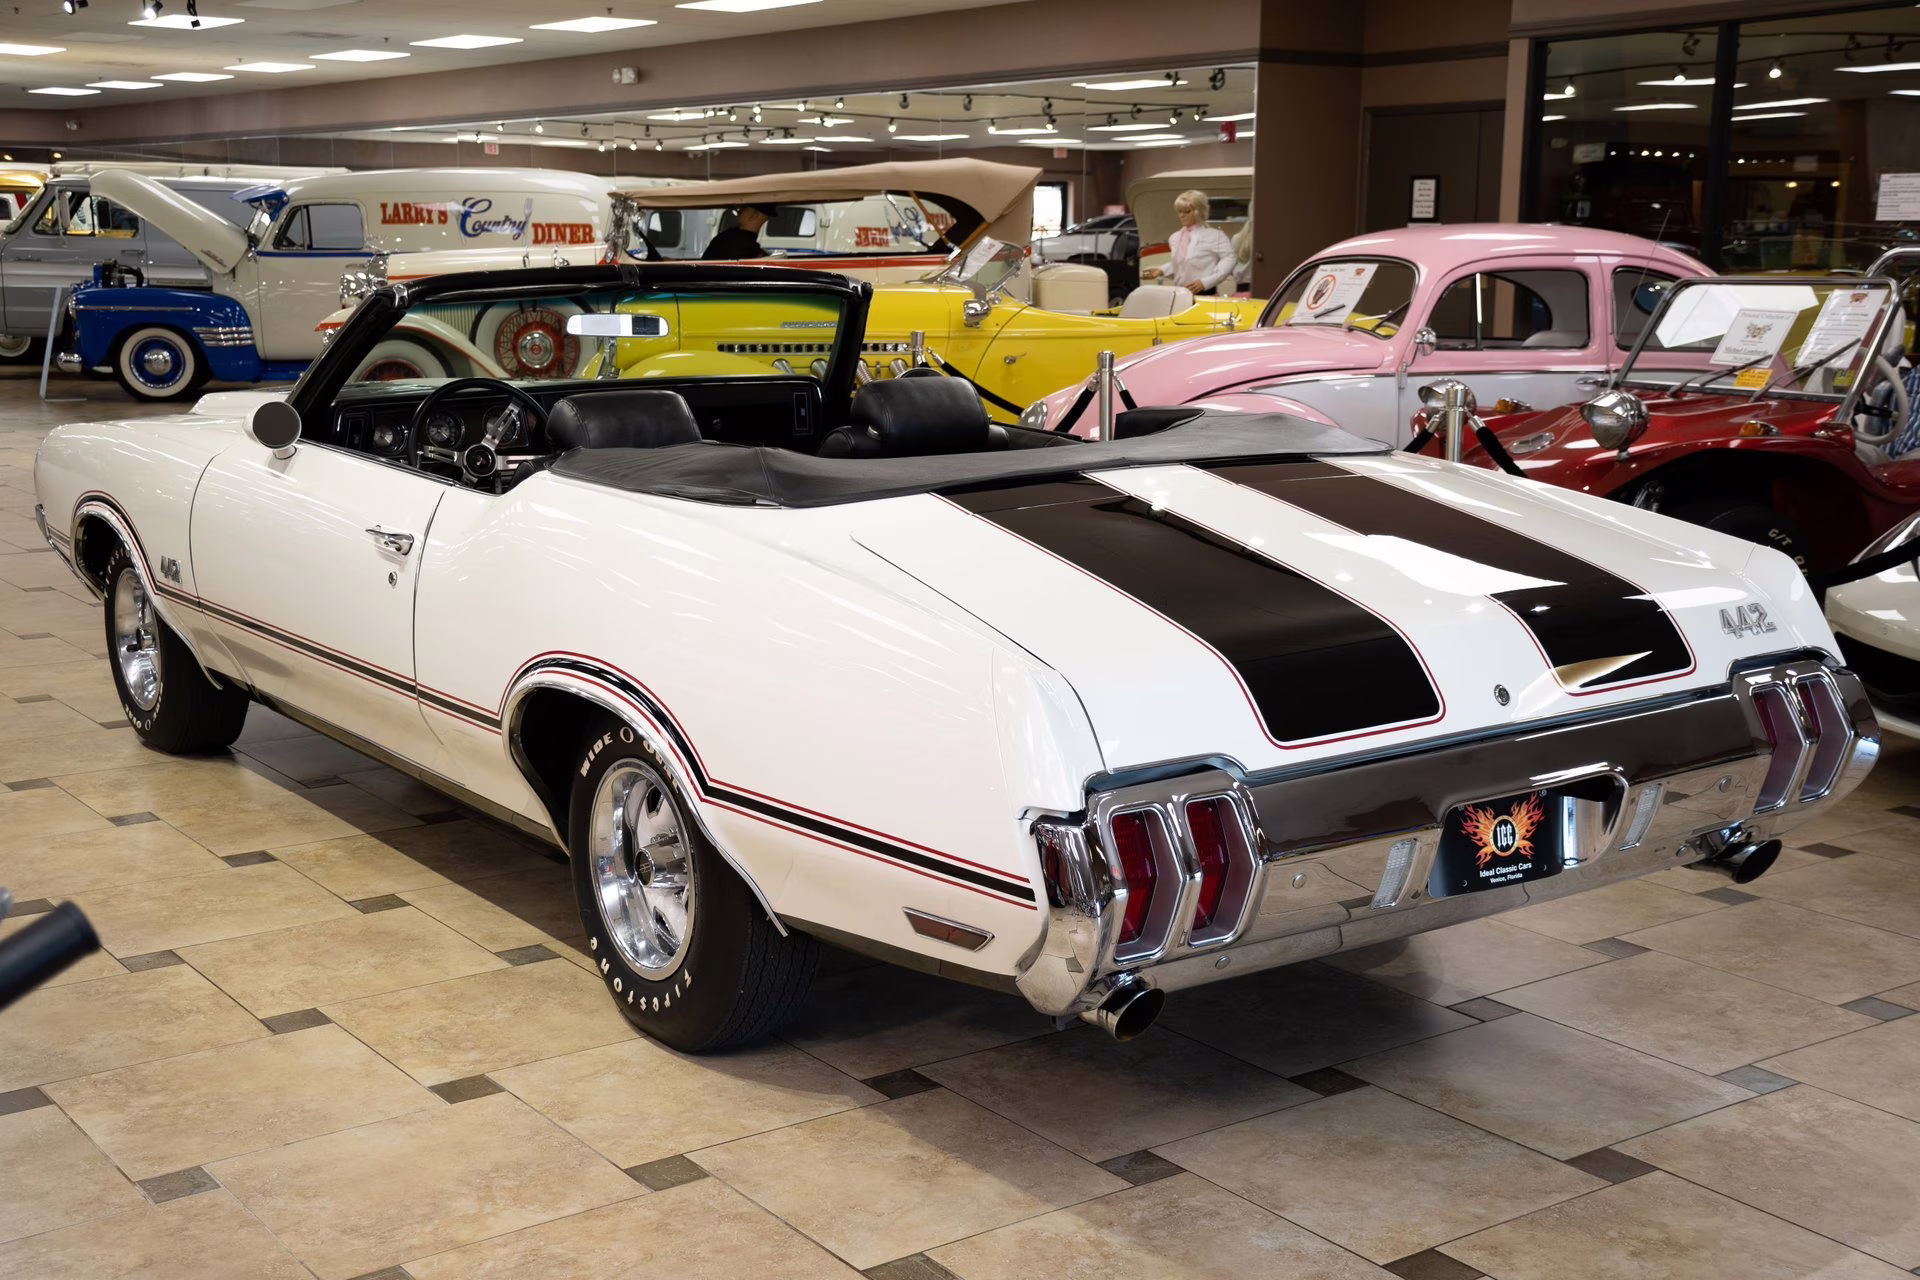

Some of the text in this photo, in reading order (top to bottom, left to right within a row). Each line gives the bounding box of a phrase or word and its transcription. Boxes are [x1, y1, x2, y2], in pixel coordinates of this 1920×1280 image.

[380, 197, 595, 245] LARRY'S Country DINER
[1768, 528, 1793, 546] G/T
[1719, 603, 1778, 639] 442
[579, 731, 614, 778] WIDE
[1479, 862, 1532, 878] Ideal Classic Cars
